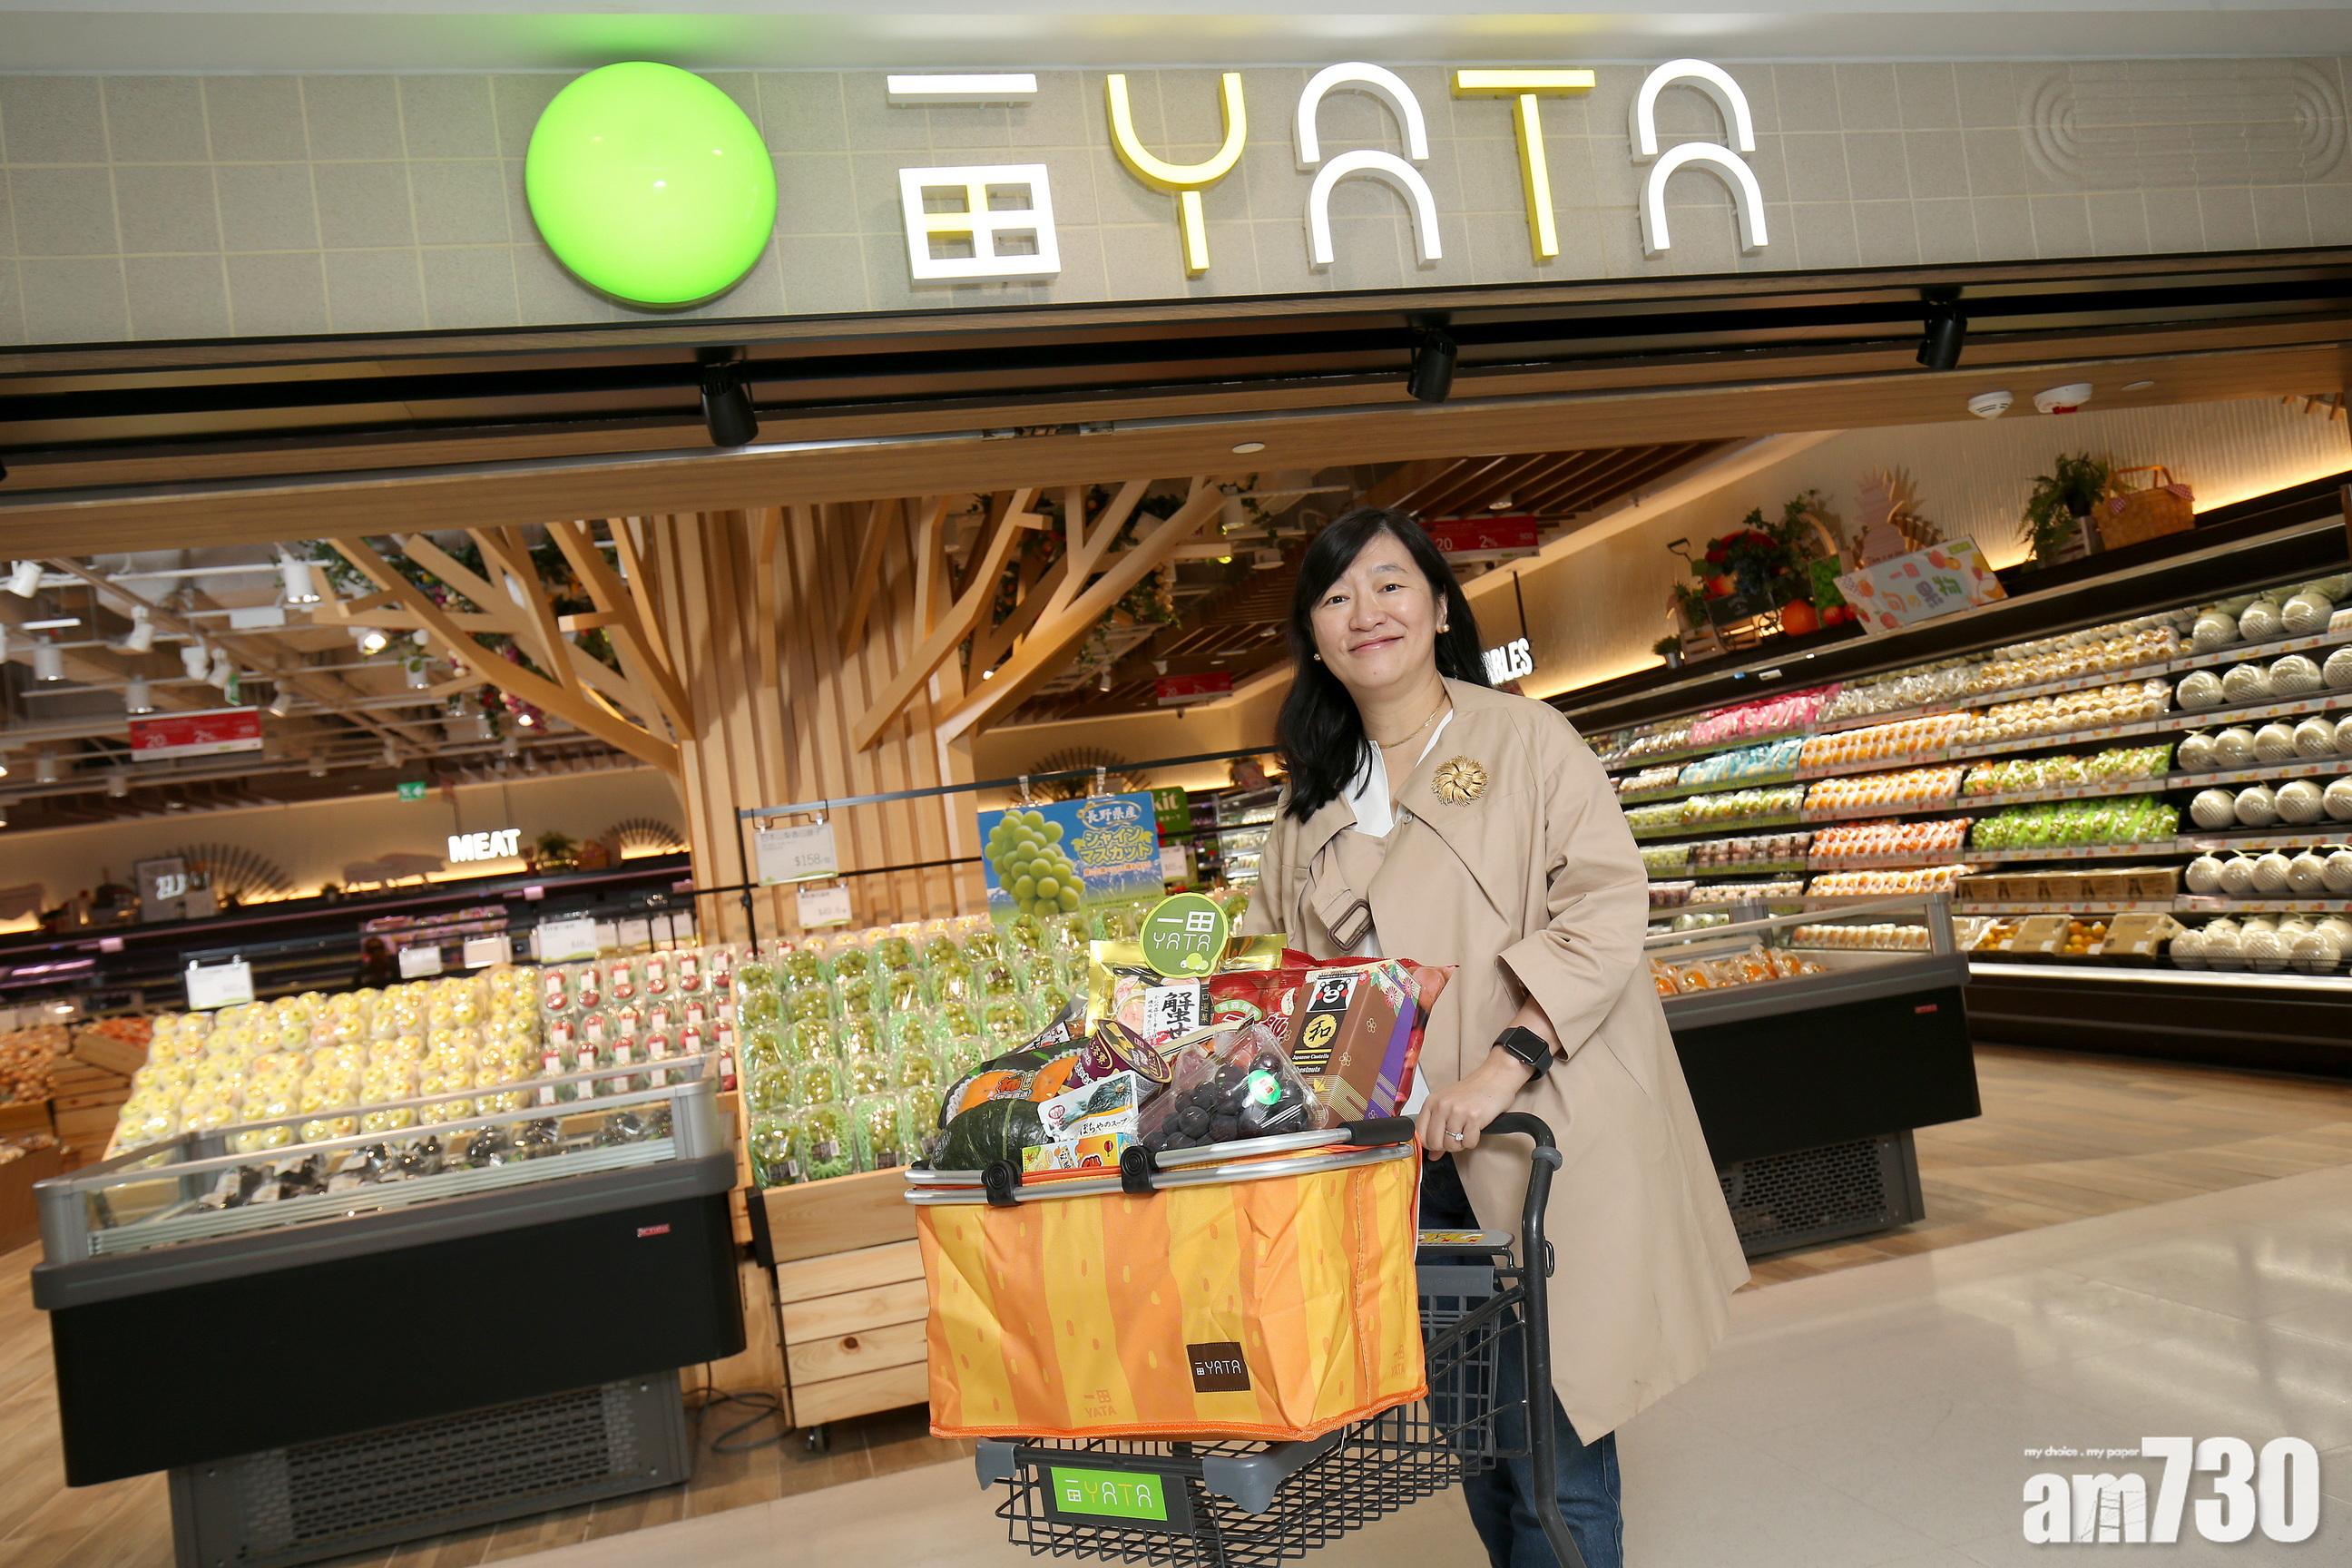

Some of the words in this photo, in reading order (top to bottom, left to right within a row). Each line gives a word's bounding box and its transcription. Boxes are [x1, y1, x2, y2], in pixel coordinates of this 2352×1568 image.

[887, 74, 1062, 285] 一田
[1106, 58, 1770, 277] YATA
[447, 828, 521, 864] MEAT
[1083, 825, 1144, 849] シャイン
[1079, 840, 1154, 867] マスカット
[1157, 911, 1216, 933] 一田
[1153, 931, 1211, 952] YATA
[1309, 1019, 1331, 1042] 和
[1205, 1359, 1242, 1375] YATA
[1083, 1406, 1118, 1418] YATA
[1083, 1481, 1152, 1509] YATA
